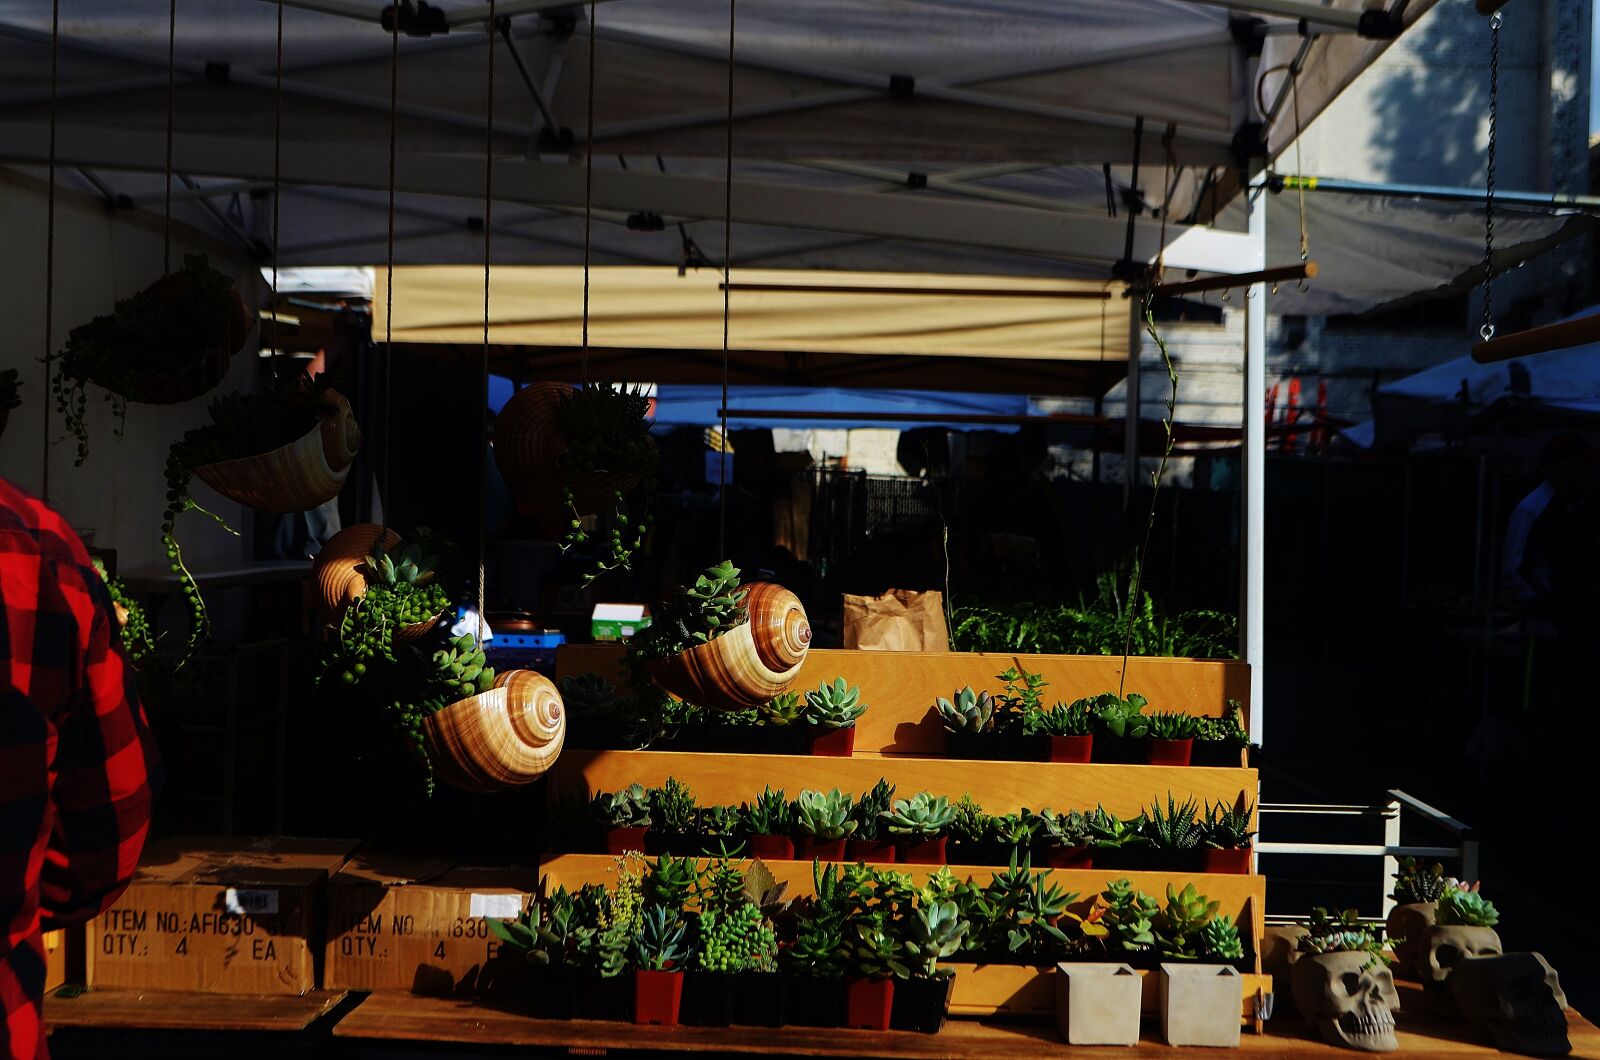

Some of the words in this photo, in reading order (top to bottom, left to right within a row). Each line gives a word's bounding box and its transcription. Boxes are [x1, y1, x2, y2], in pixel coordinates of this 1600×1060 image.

[103, 910, 146, 930] ITEM
[342, 912, 382, 935] ITEM
[175, 935, 188, 957] 4
[252, 938, 277, 961] EA
[342, 937, 388, 957] QTY.:
[433, 940, 446, 961] 4
